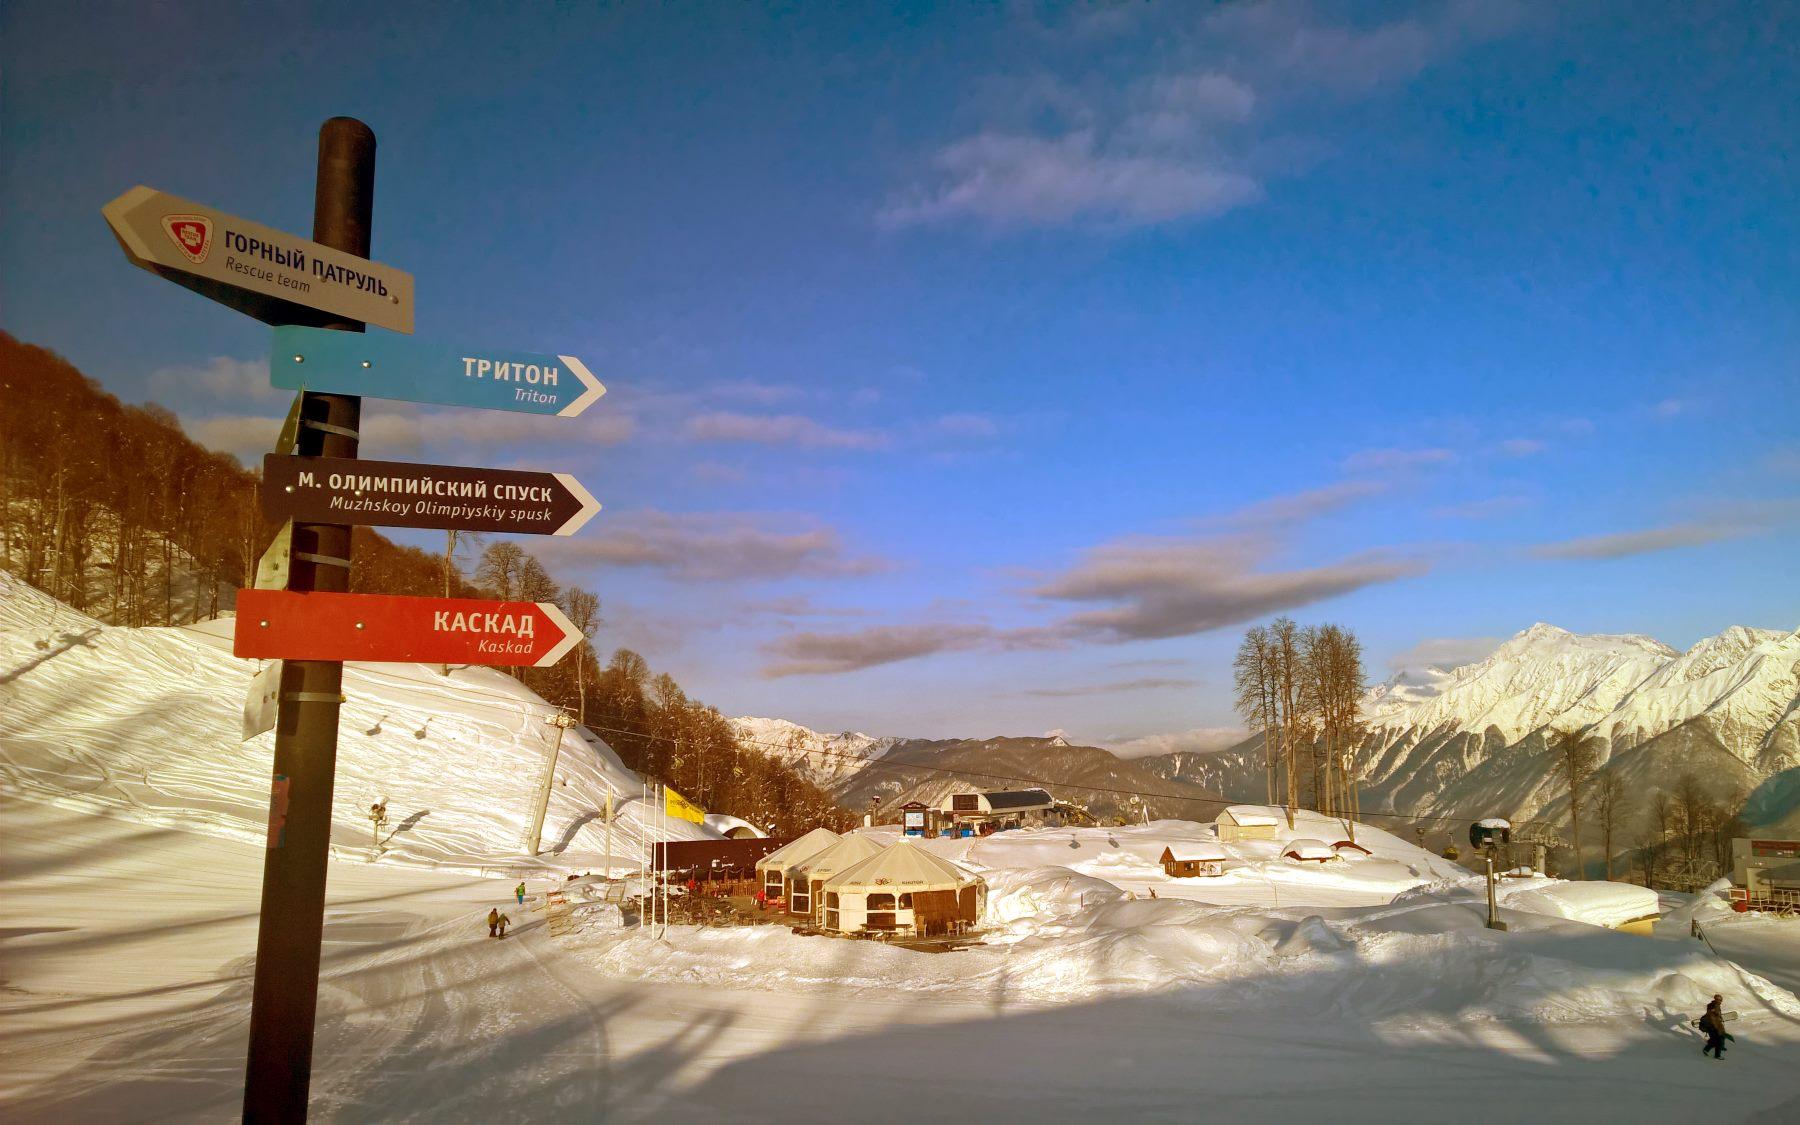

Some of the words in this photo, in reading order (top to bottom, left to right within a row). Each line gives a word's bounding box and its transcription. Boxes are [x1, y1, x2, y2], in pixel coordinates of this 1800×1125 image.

[226, 231, 304, 271] ГОРНЫЙ
[313, 259, 387, 296] ПАТРУЛЬ
[226, 256, 273, 281] Rescue
[278, 273, 310, 292] team
[463, 357, 557, 385] ТРИТОН
[515, 388, 557, 404] Triton
[298, 471, 321, 488] М.
[329, 473, 487, 498] ОЛИМПИЙСКИЙ
[493, 484, 552, 503] СПУСК
[330, 496, 410, 516] Muzhskoy
[415, 500, 505, 521] Olimpiyskiy
[509, 508, 552, 522] spusk
[434, 611, 534, 638] КАСКАД
[478, 640, 534, 654] Kaskad
